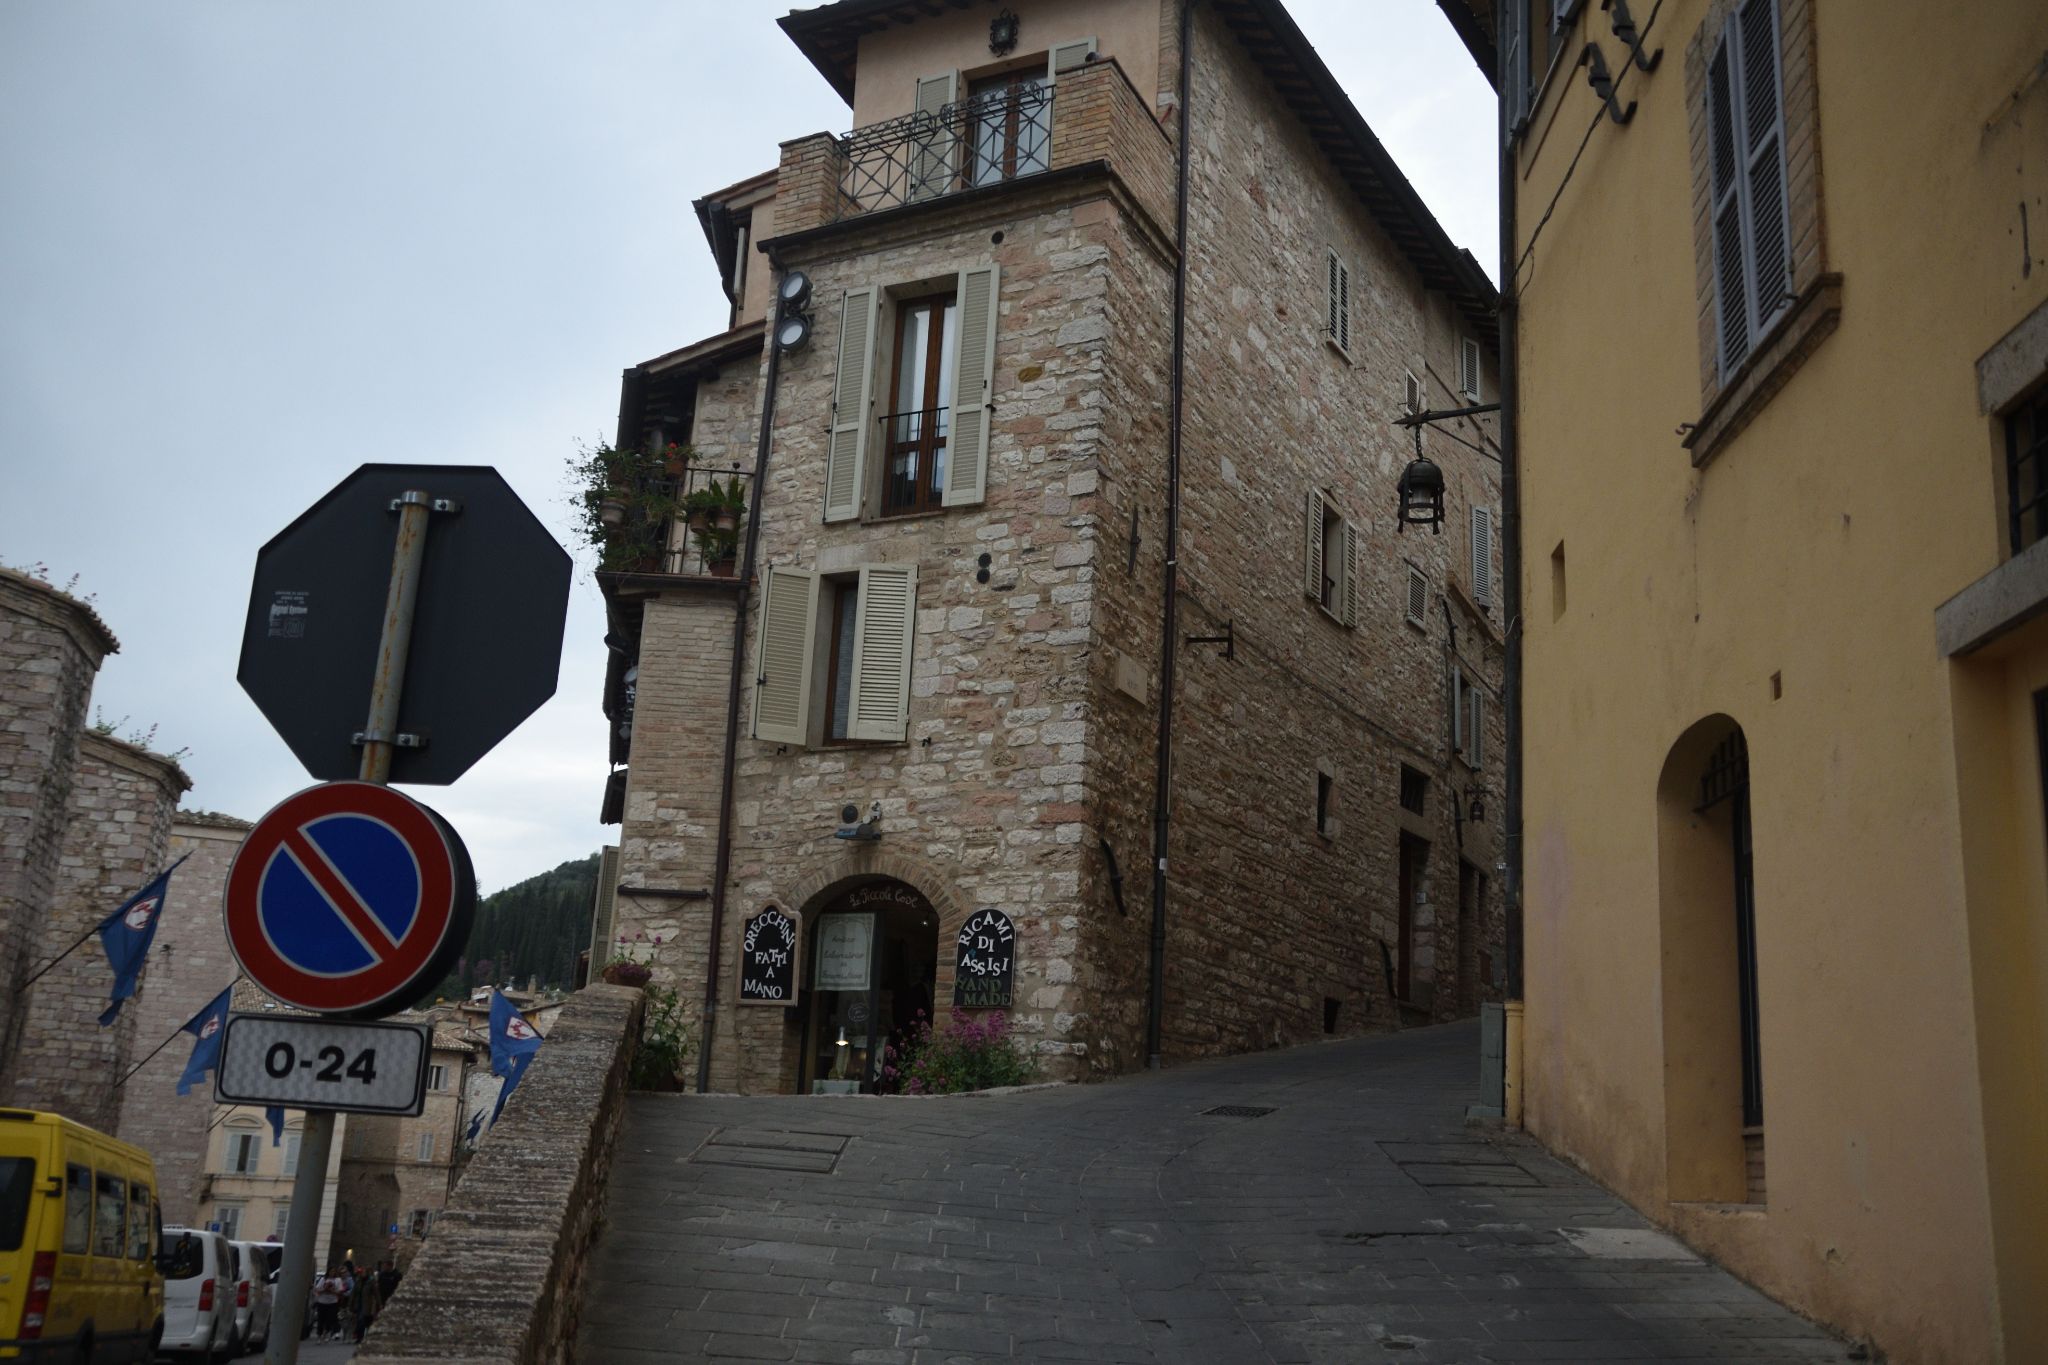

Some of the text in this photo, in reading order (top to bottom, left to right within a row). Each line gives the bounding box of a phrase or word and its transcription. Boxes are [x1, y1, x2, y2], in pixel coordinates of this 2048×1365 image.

[743, 911, 796, 953] ORECCHINI
[958, 911, 1013, 947] RICAMI
[977, 935, 995, 953] DI
[754, 948, 788, 968] FATTI
[960, 953, 1010, 977] ASSISI
[765, 965, 775, 979] A
[743, 978, 783, 999] MANO
[963, 992, 1011, 1006] MADE
[264, 1041, 377, 1085] 0-24
